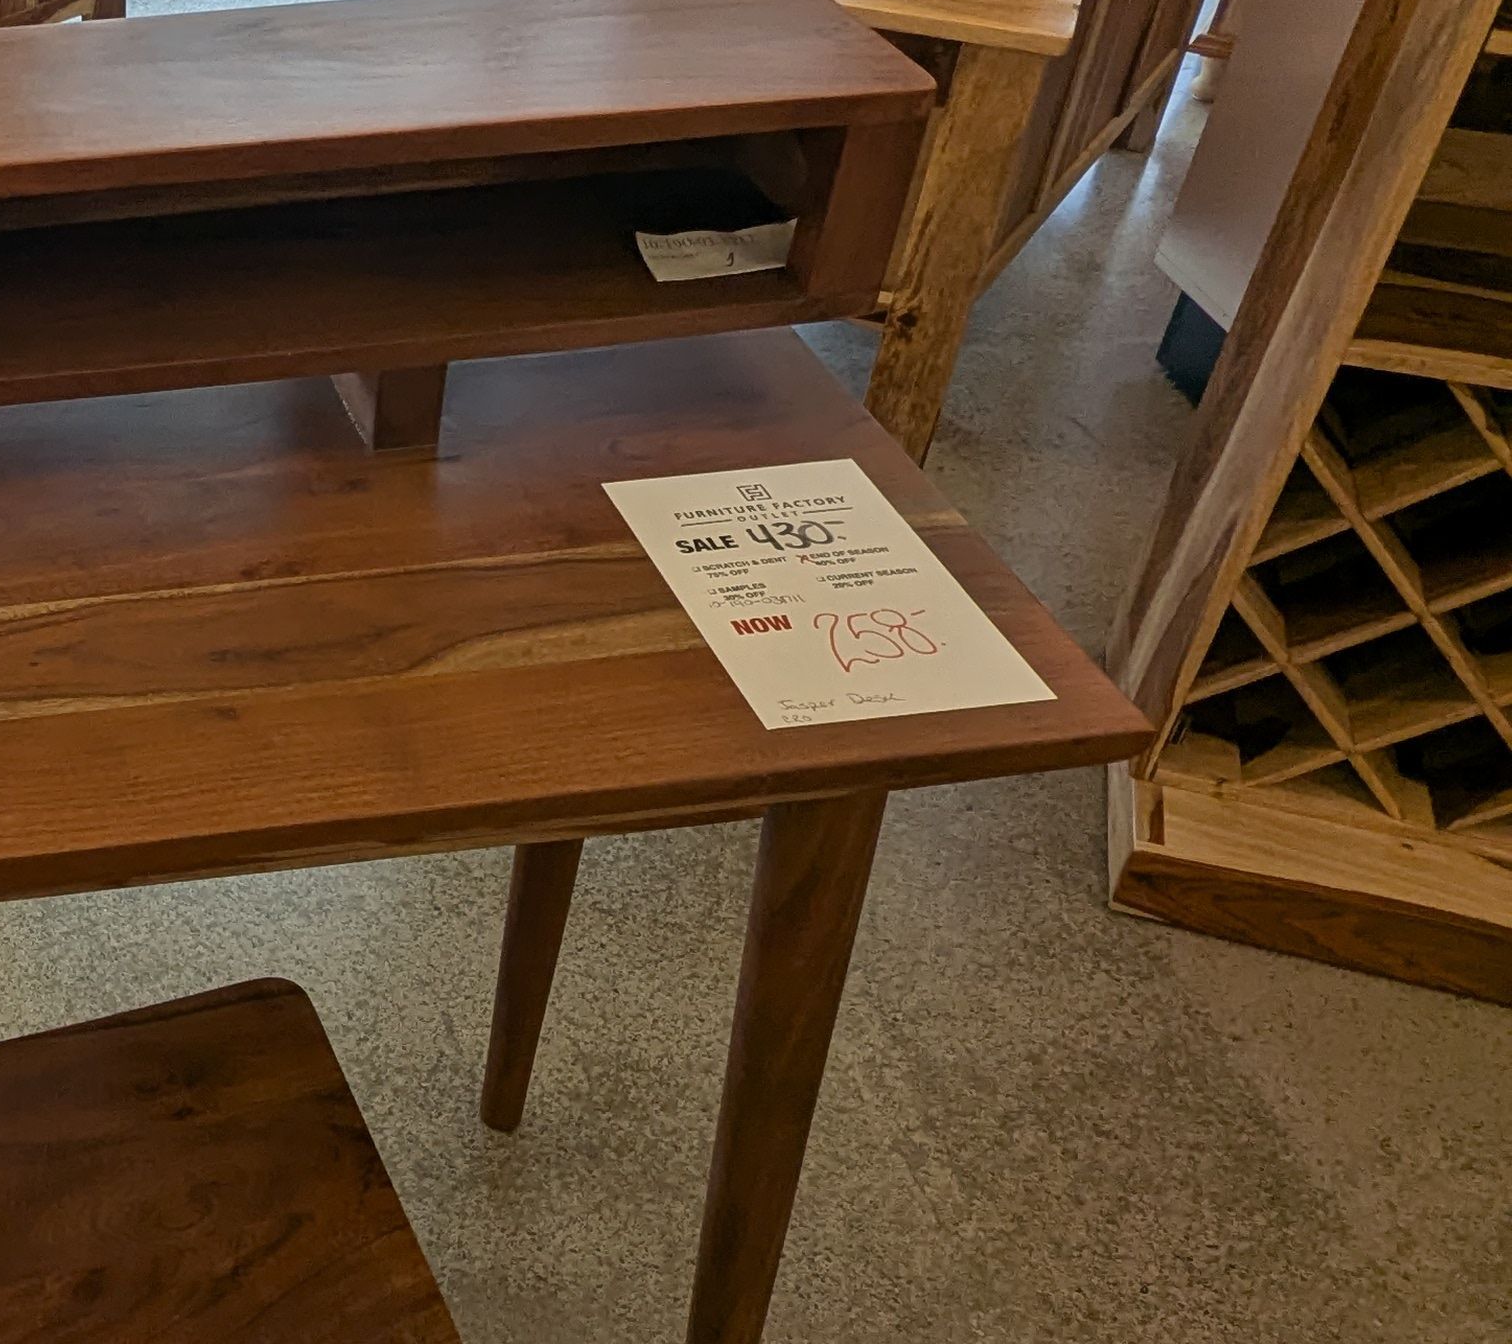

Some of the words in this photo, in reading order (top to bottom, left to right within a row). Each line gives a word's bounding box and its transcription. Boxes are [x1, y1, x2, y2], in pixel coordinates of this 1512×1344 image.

[674, 504, 767, 521] FURNITURE
[772, 495, 846, 510] FACTORY
[736, 509, 799, 523] OUTLET
[675, 535, 739, 554] SALE
[809, 551, 831, 560] END
[832, 549, 847, 557] OF
[849, 546, 890, 556] SEASON
[702, 560, 750, 572] SCRATCH
[760, 556, 787, 566] DENT
[836, 556, 858, 566] OFF
[729, 567, 750, 577] OFF
[826, 571, 874, 583] CURRENT
[875, 567, 918, 577] SEASON
[717, 582, 767, 595] SAMPLES
[855, 578, 875, 588] OFF
[745, 590, 766, 599] OFF
[730, 614, 793, 636] NOW
